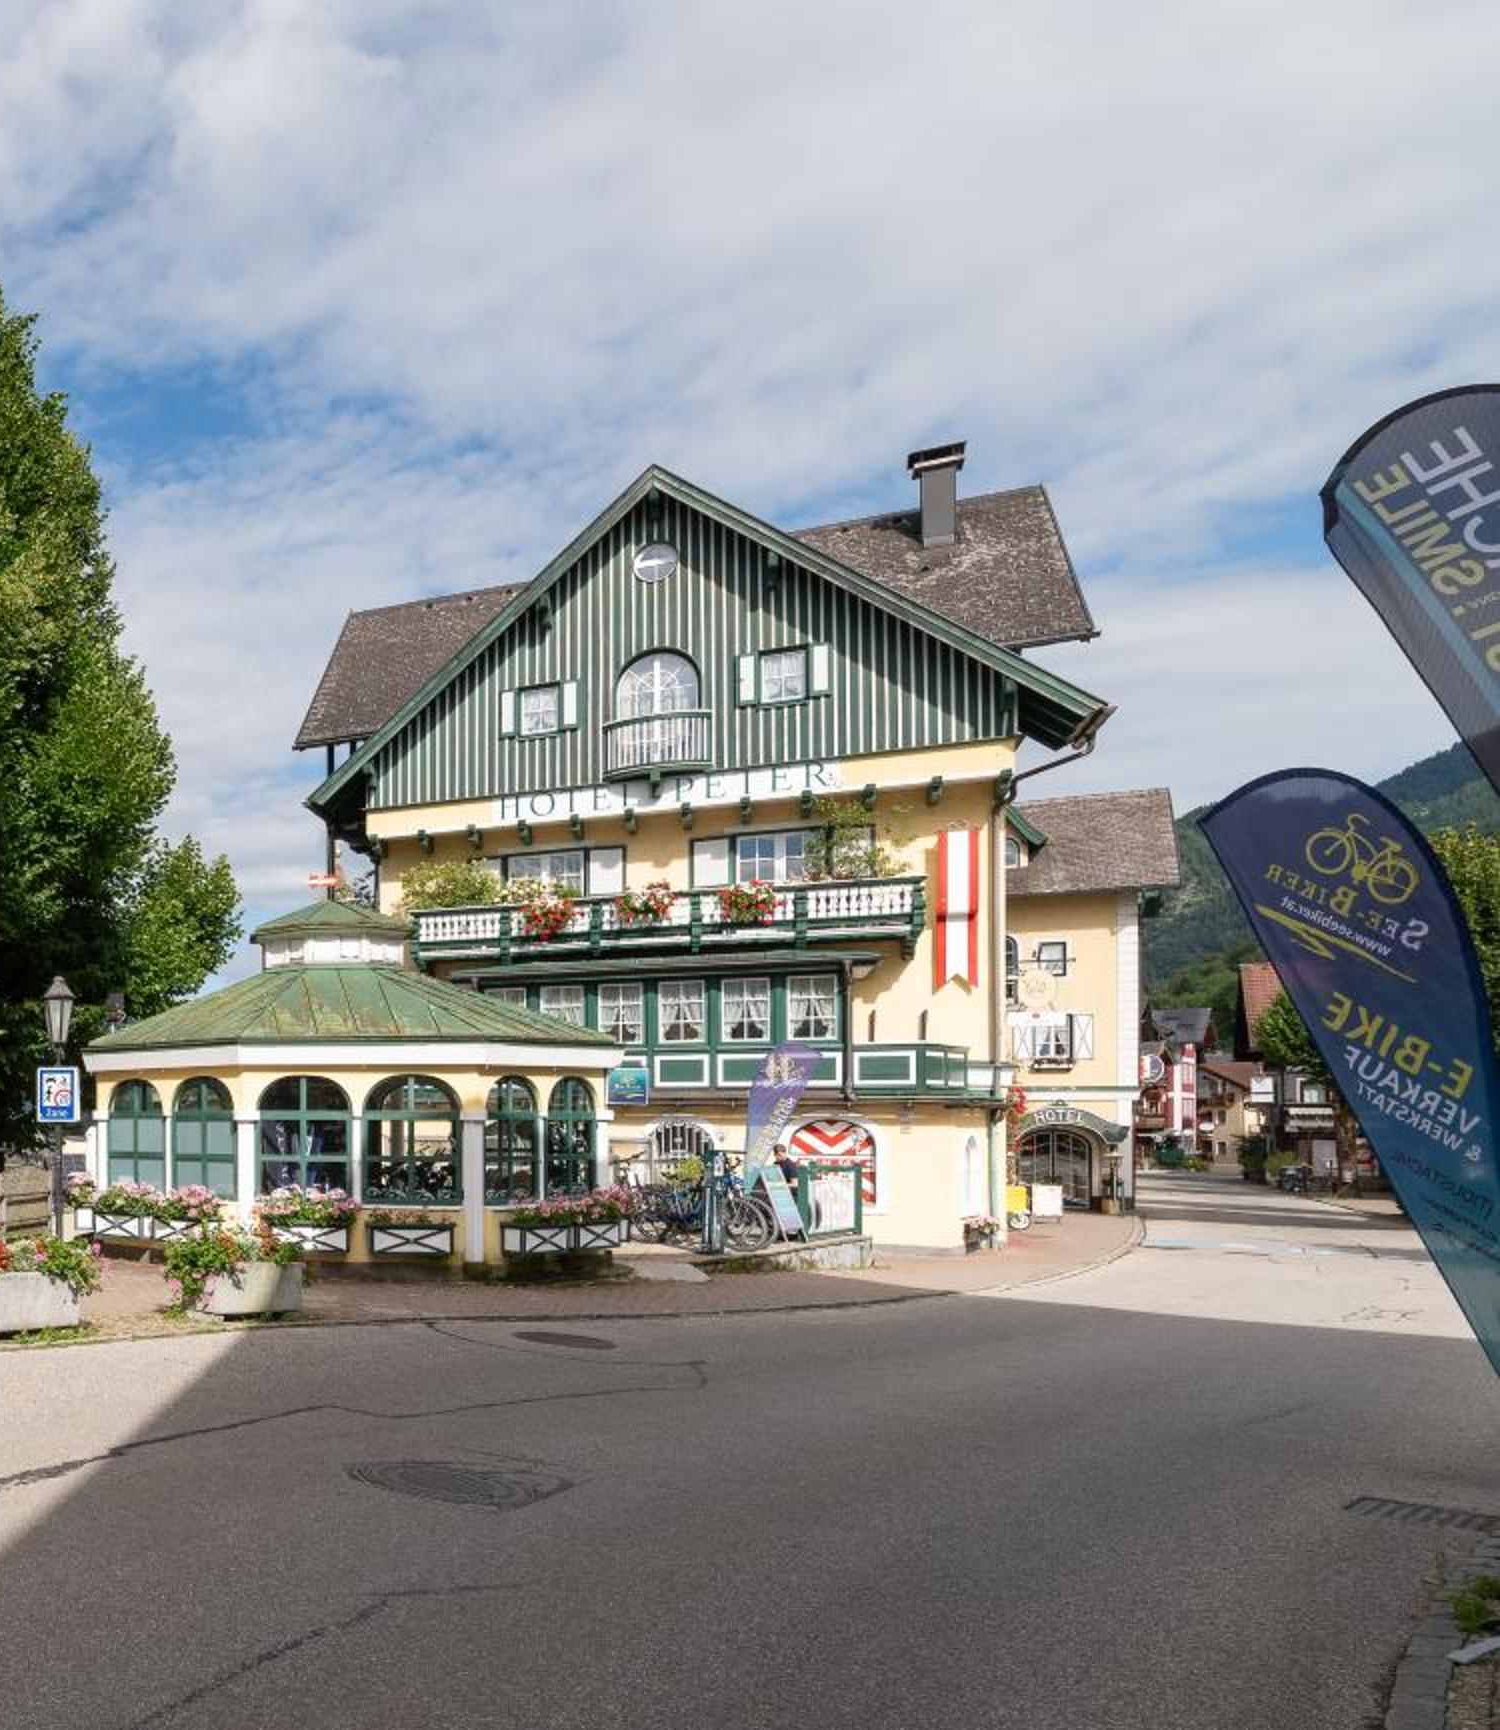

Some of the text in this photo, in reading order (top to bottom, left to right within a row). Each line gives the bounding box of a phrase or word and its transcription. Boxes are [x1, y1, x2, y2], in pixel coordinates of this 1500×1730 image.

[501, 763, 828, 819] HOTEL PETER
[1032, 1109, 1083, 1126] HOTEL
